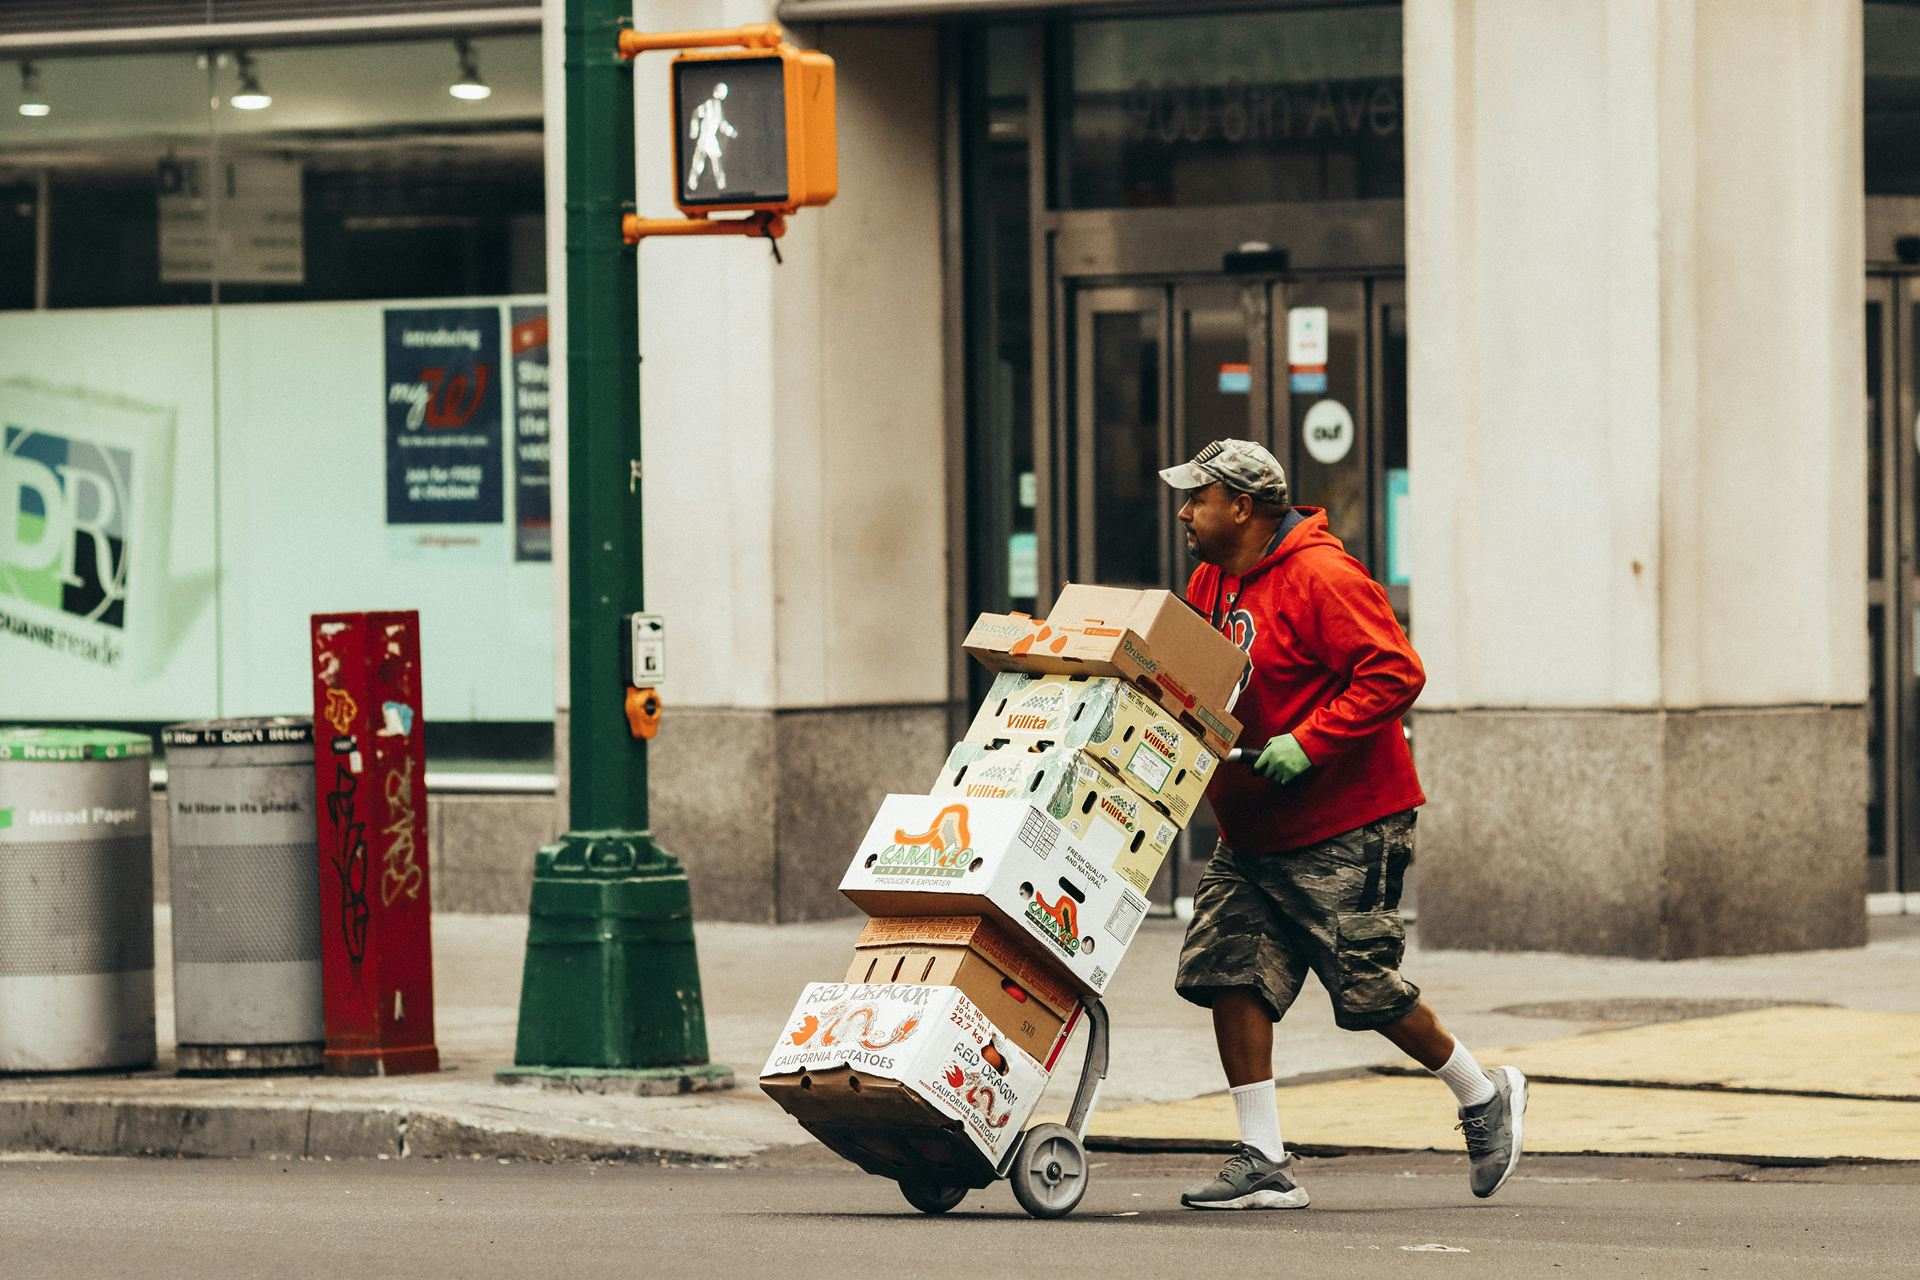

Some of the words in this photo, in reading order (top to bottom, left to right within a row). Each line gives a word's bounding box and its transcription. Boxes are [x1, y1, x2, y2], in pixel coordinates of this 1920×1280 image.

[1308, 82, 1399, 136] Ave
[1007, 714, 1047, 730] Villita
[222, 728, 263, 743] Don't
[269, 728, 305, 741] litter
[1144, 729, 1170, 757] Villita
[966, 783, 1008, 798] Villita
[30, 808, 88, 824] Mixed
[92, 807, 136, 824] Paper
[224, 803, 236, 813] in
[240, 802, 257, 813] its
[880, 844, 974, 868] CARAVEO
[1067, 845, 1085, 864] FRESH
[1085, 862, 1108, 883] QUALITY
[1065, 855, 1077, 867] AND
[1077, 864, 1101, 888] NATURAL
[916, 879, 951, 888] EXPORTER
[1028, 901, 1079, 950] CARAVEO
[807, 984, 847, 1004] RED
[853, 984, 930, 1005] DRAGON
[959, 996, 970, 1012] U.S.
[955, 1005, 964, 1014] 50
[950, 1012, 972, 1031] 22.7
[972, 1029, 984, 1045] kg
[774, 1051, 831, 1067] CALIFORNIA
[834, 1049, 895, 1069] POTATOES
[953, 1042, 980, 1067] RED
[982, 1064, 1018, 1105] DRAGON
[932, 1080, 970, 1116] CALIFORNIA
[970, 1112, 996, 1143] POTATOES
